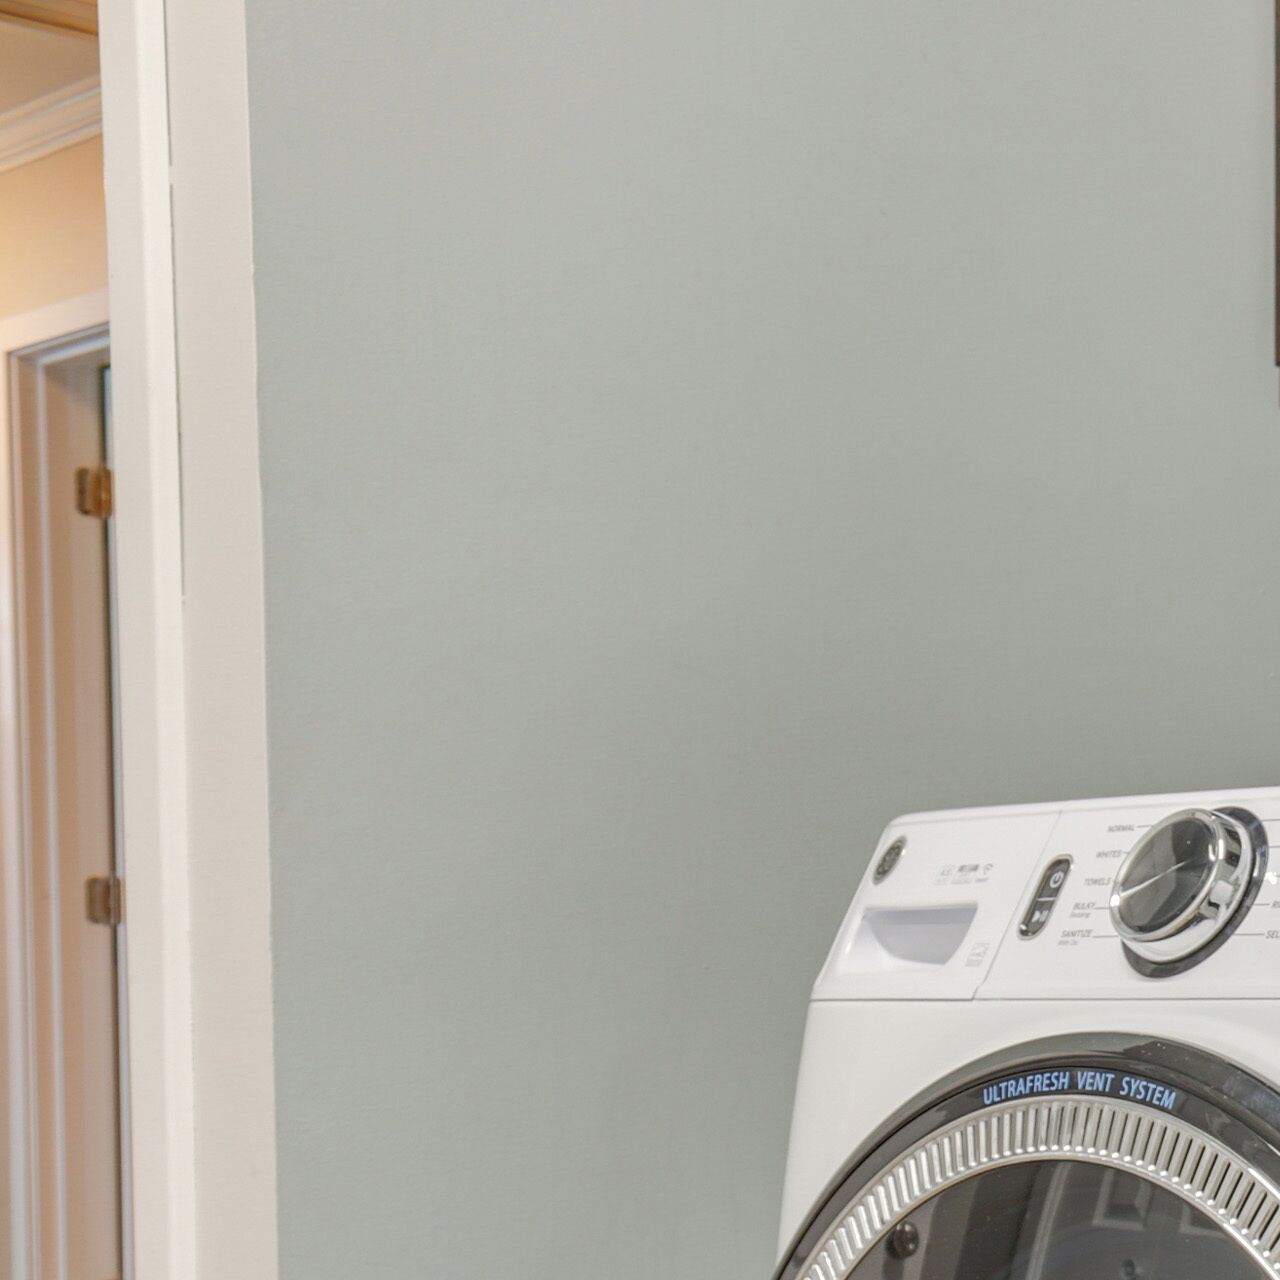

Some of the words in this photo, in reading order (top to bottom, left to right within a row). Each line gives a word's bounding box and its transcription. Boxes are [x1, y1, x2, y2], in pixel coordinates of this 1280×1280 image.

[983, 1071, 1070, 1105] ULTRAFRESH
[1077, 1071, 1115, 1092] VENT
[1119, 1076, 1177, 1110] SYSTEM
